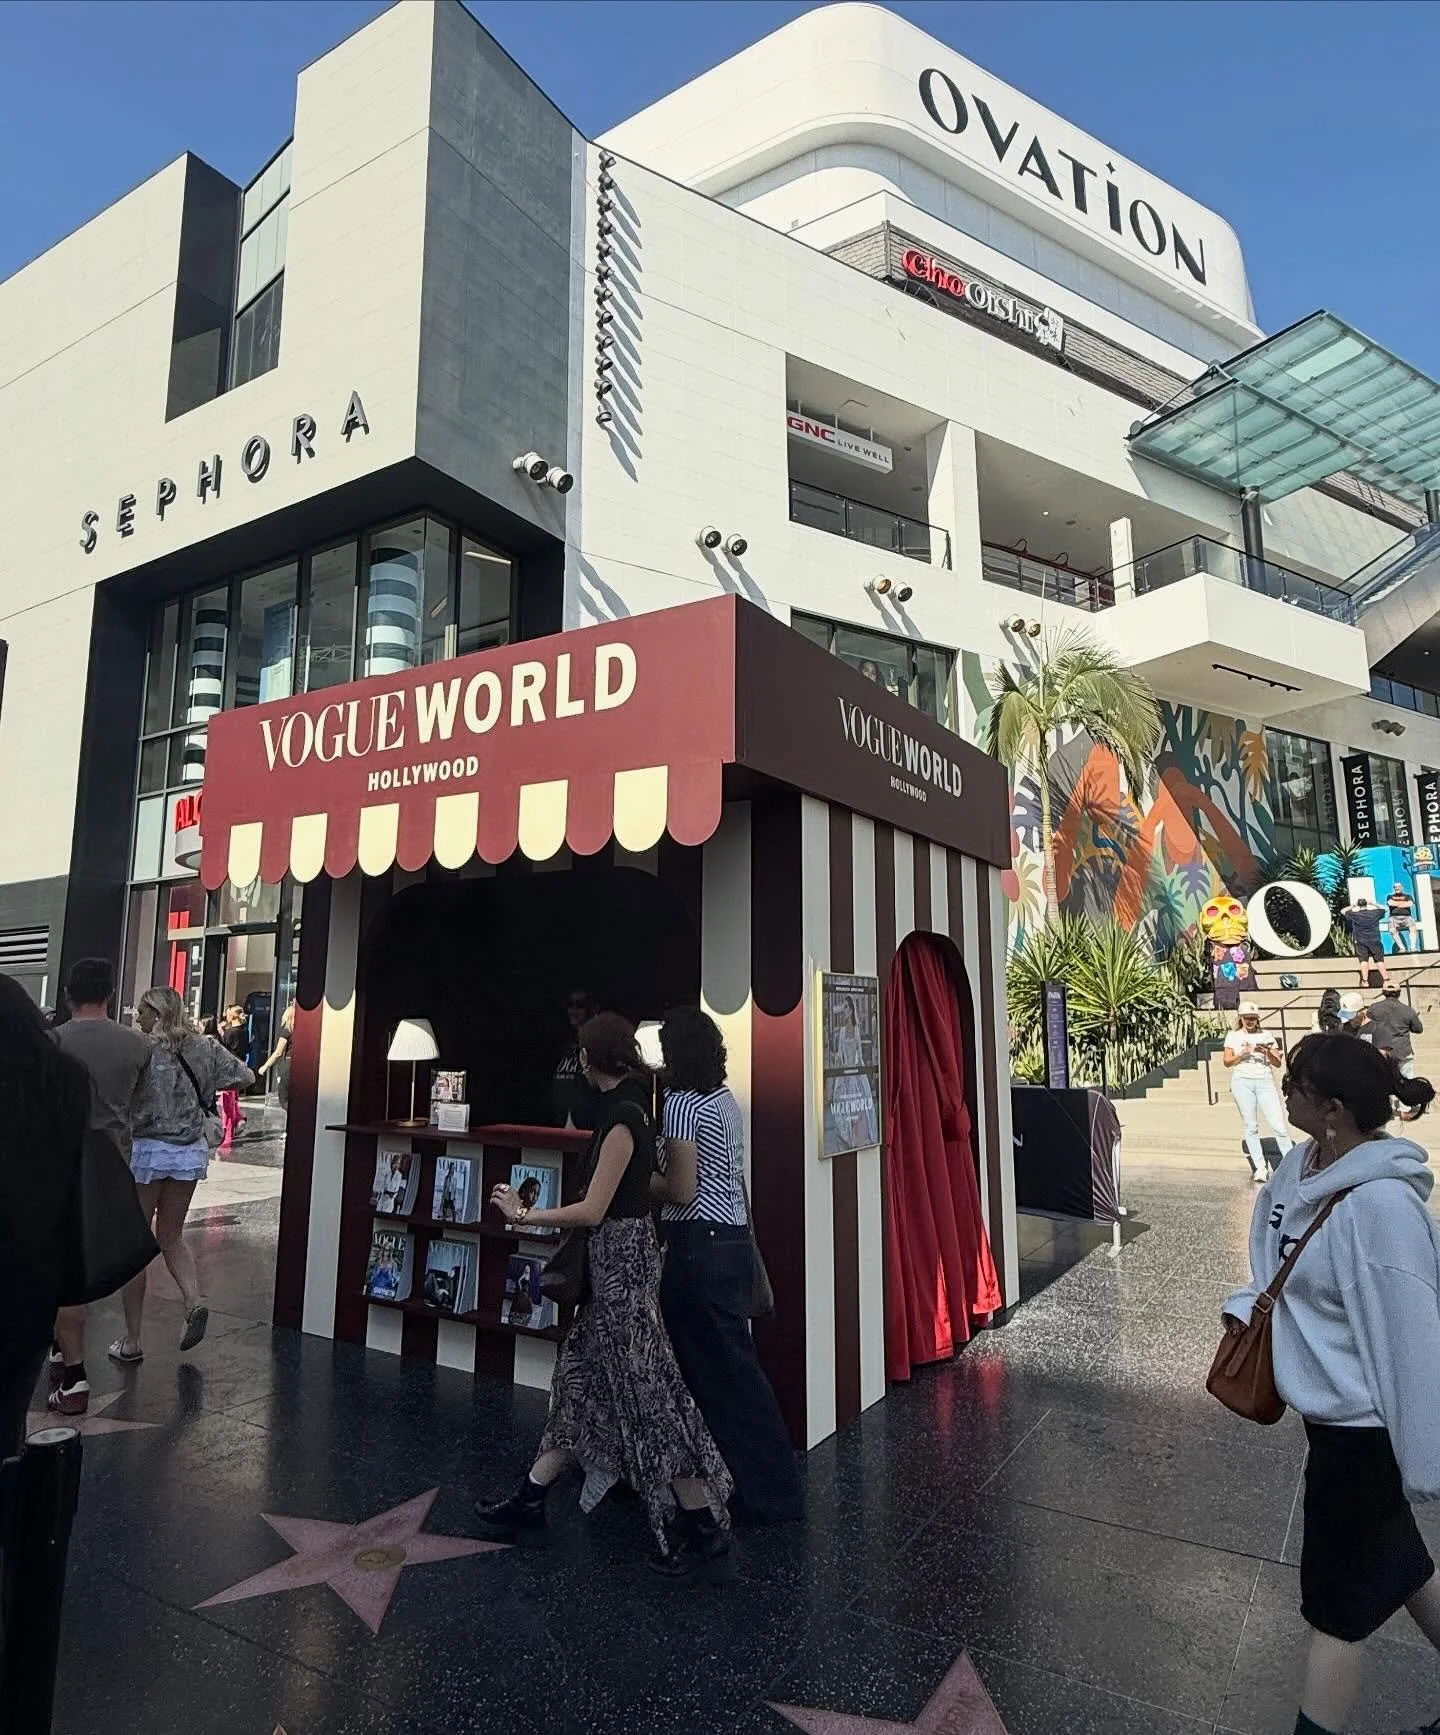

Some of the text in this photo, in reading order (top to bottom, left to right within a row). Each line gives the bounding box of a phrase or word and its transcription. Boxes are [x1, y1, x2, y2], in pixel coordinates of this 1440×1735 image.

[902, 248, 966, 297] Cho
[787, 416, 890, 463] GNC LIVE WELL
[79, 390, 370, 555] SEPHORA
[260, 642, 638, 772] VOGUE WORLD
[838, 696, 962, 798] VOGUE WORLD
[367, 756, 480, 792] HOLLYWOOD
[890, 775, 927, 803] HOLLYWOOD
[1351, 764, 1370, 840] SEPHORA
[1425, 782, 1440, 843] EPHORA
[438, 1159, 466, 1172] VOUE
[513, 1167, 551, 1184] VOGUE
